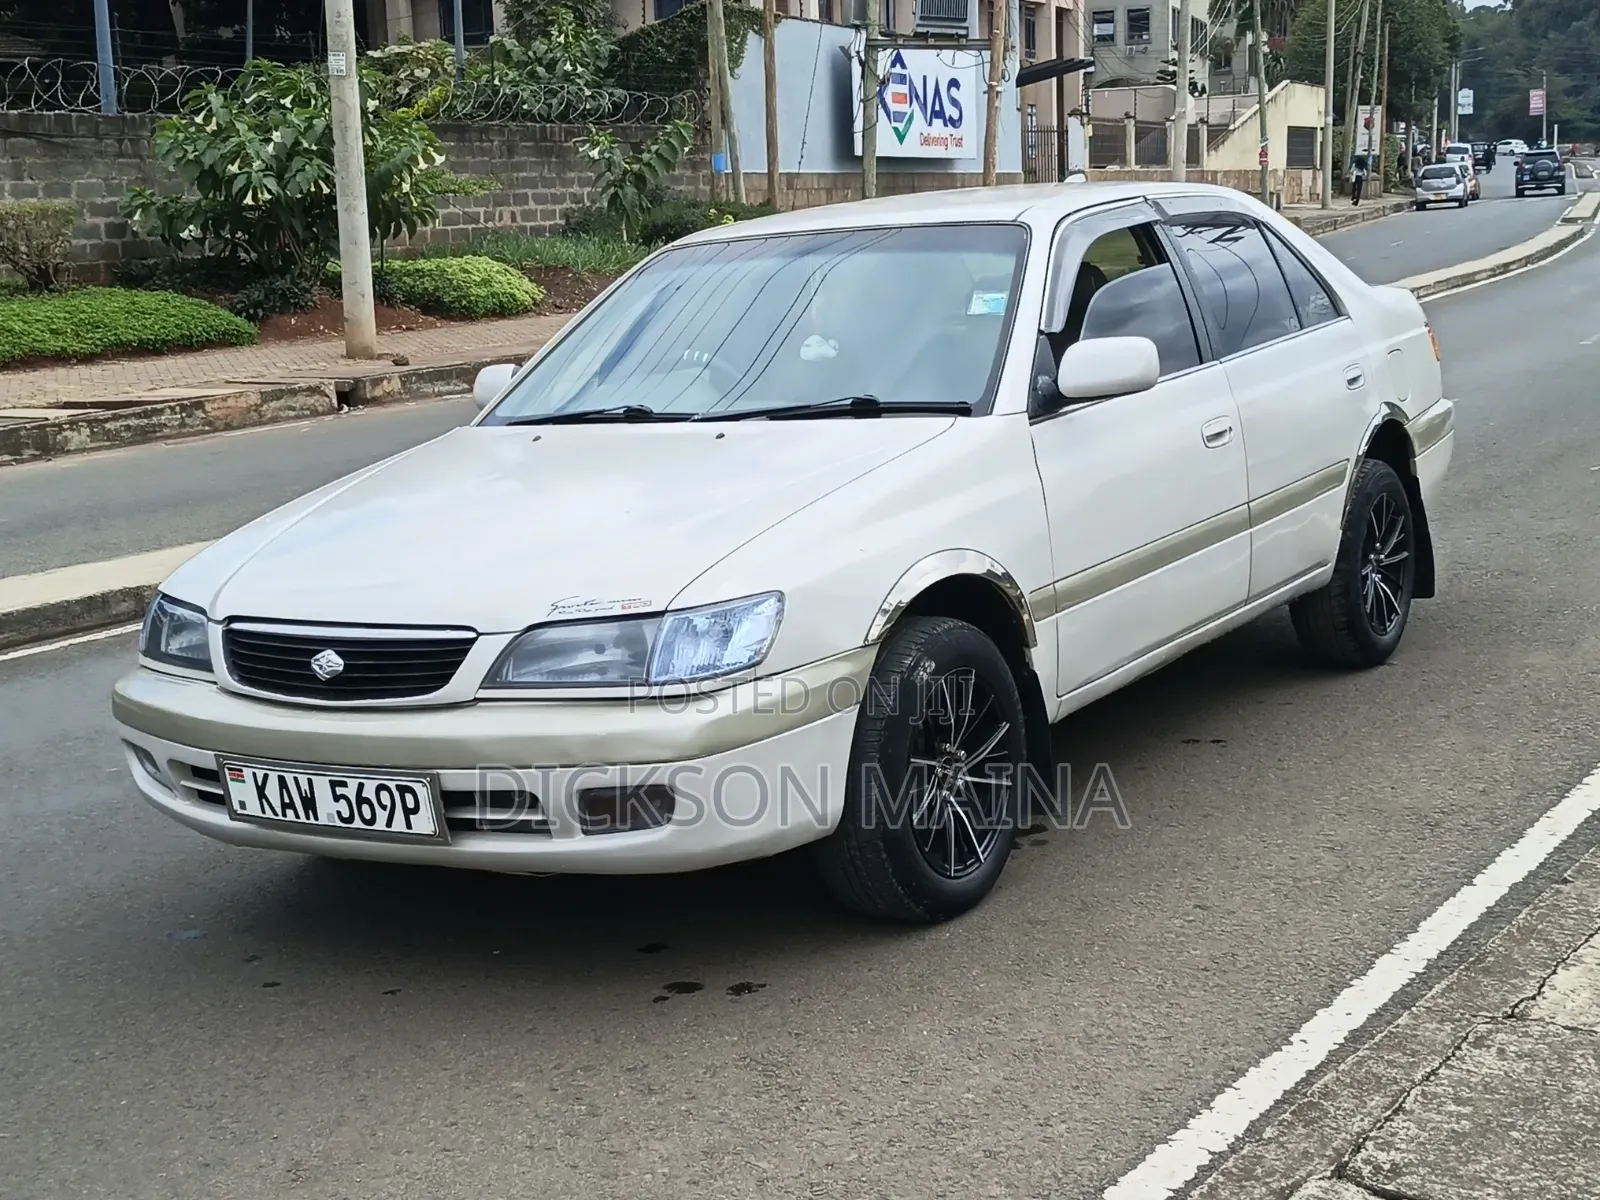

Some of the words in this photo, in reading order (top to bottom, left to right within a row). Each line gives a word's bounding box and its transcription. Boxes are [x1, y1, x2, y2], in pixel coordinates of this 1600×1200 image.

[919, 132, 948, 150] Delivering
[949, 134, 964, 148] Trust
[252, 771, 319, 822] KAW
[328, 779, 421, 830] 569P
